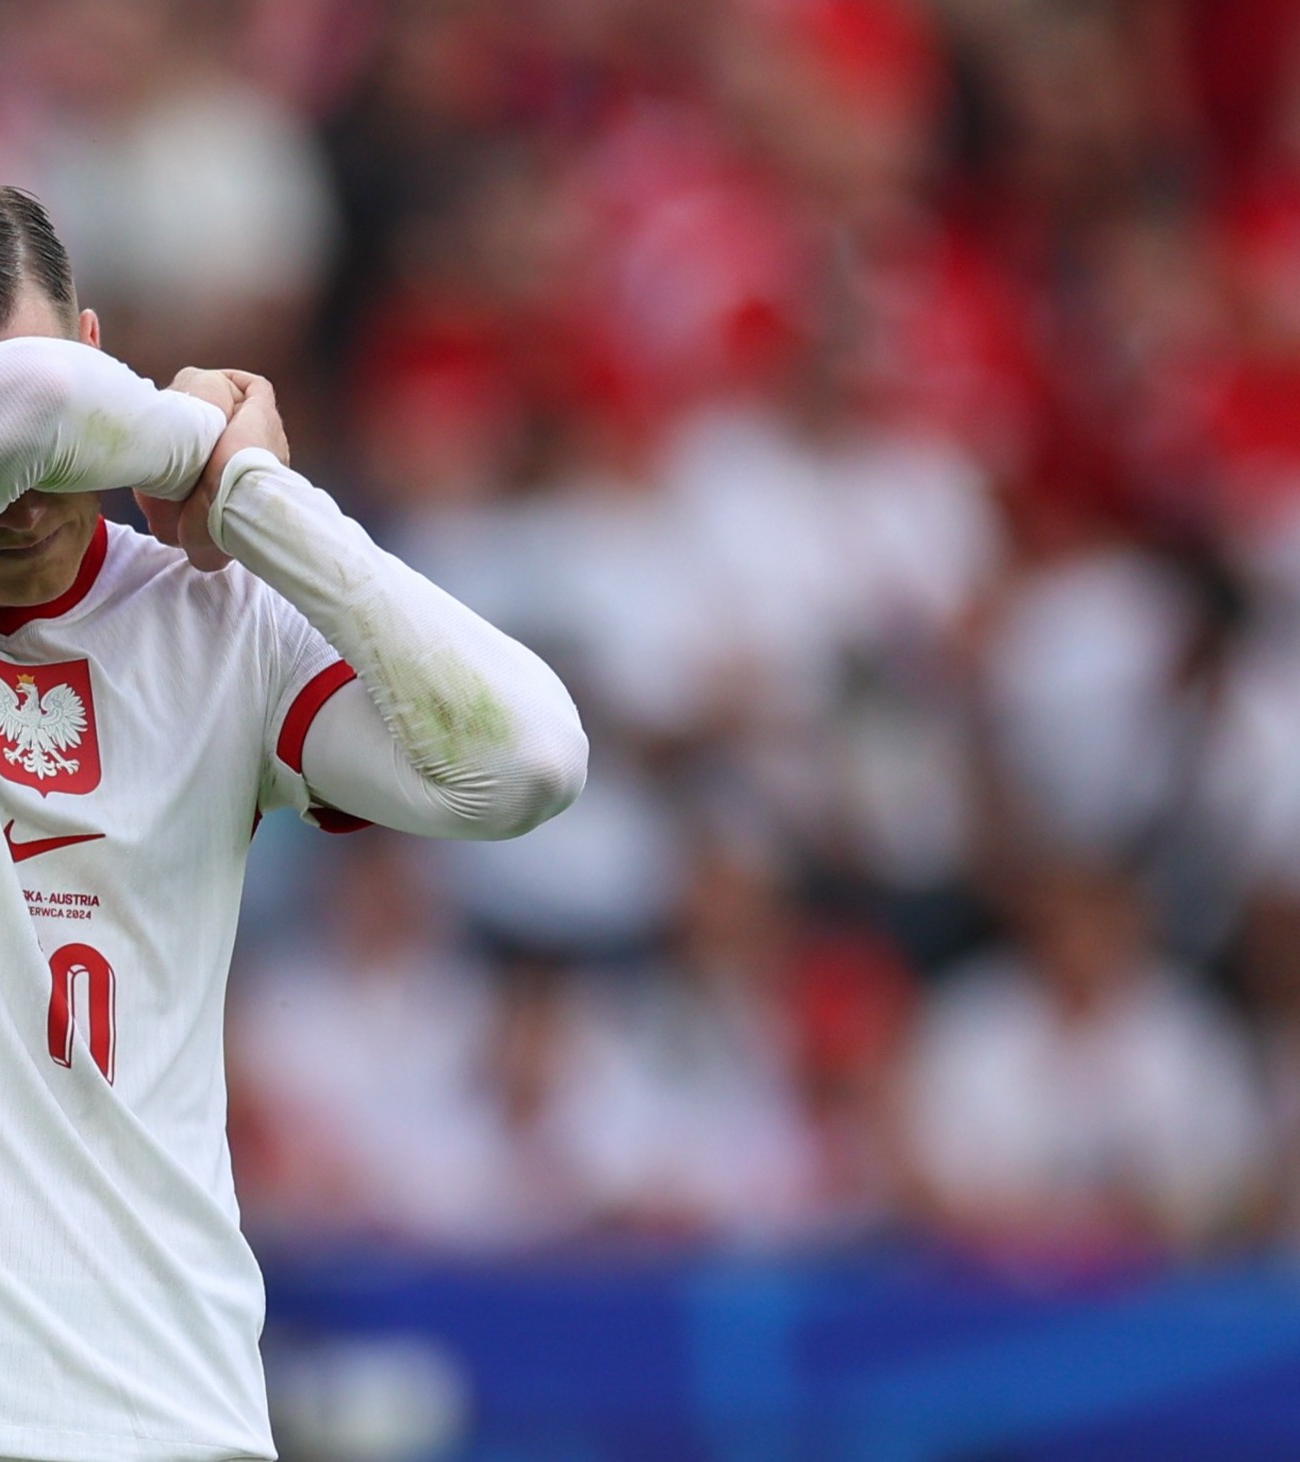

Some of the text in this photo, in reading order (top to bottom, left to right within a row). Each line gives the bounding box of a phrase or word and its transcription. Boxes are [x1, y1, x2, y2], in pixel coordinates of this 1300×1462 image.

[49, 892, 100, 907] AUSTRIA
[28, 905, 92, 920] ERWCA 2024
